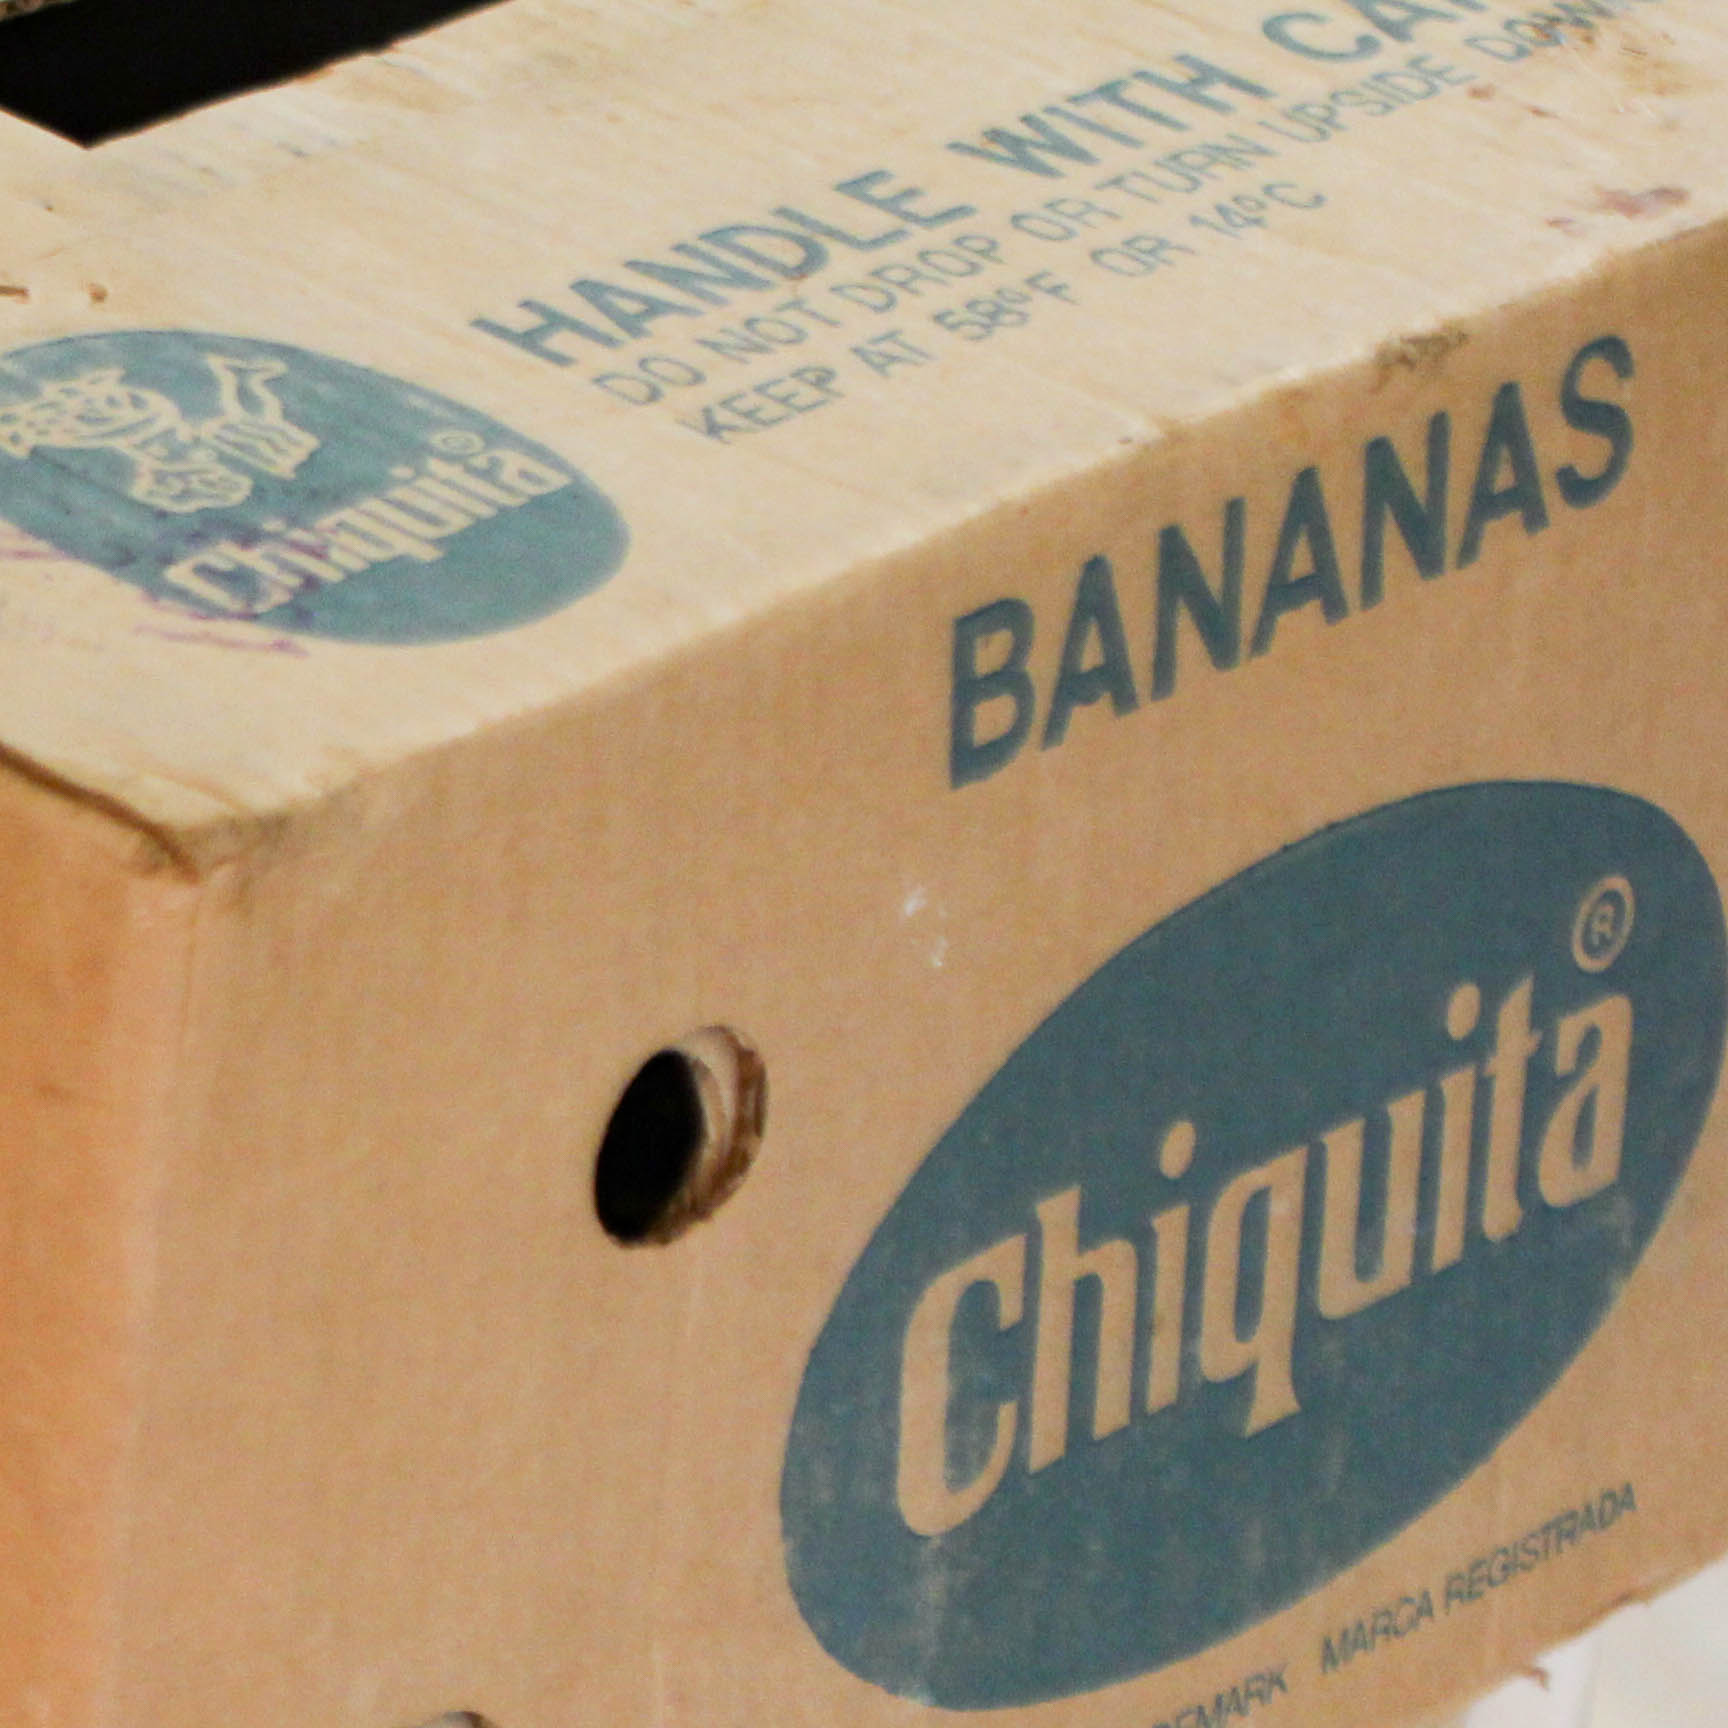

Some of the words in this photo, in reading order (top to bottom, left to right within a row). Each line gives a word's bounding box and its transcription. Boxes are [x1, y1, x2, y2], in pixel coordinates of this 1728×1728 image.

[469, 169, 979, 368] HANDLE
[944, 52, 1276, 179] WITH
[592, 355, 708, 406] DO
[696, 299, 843, 364] NOT
[830, 233, 1009, 315] DROP
[1009, 198, 1122, 243] OR
[1094, 131, 1280, 203] TURN
[1257, 54, 1478, 144] UPSIDE
[674, 365, 845, 445] KEEP
[849, 329, 939, 378] AT
[1090, 234, 1198, 277] OR
[162, 448, 573, 615] Chiquita
[949, 334, 1636, 790] BANANAS
[895, 973, 1634, 1538] Chiquita
[1318, 1588, 1437, 1677] MARCA
[1442, 1480, 1639, 1615] REGISTRADA
